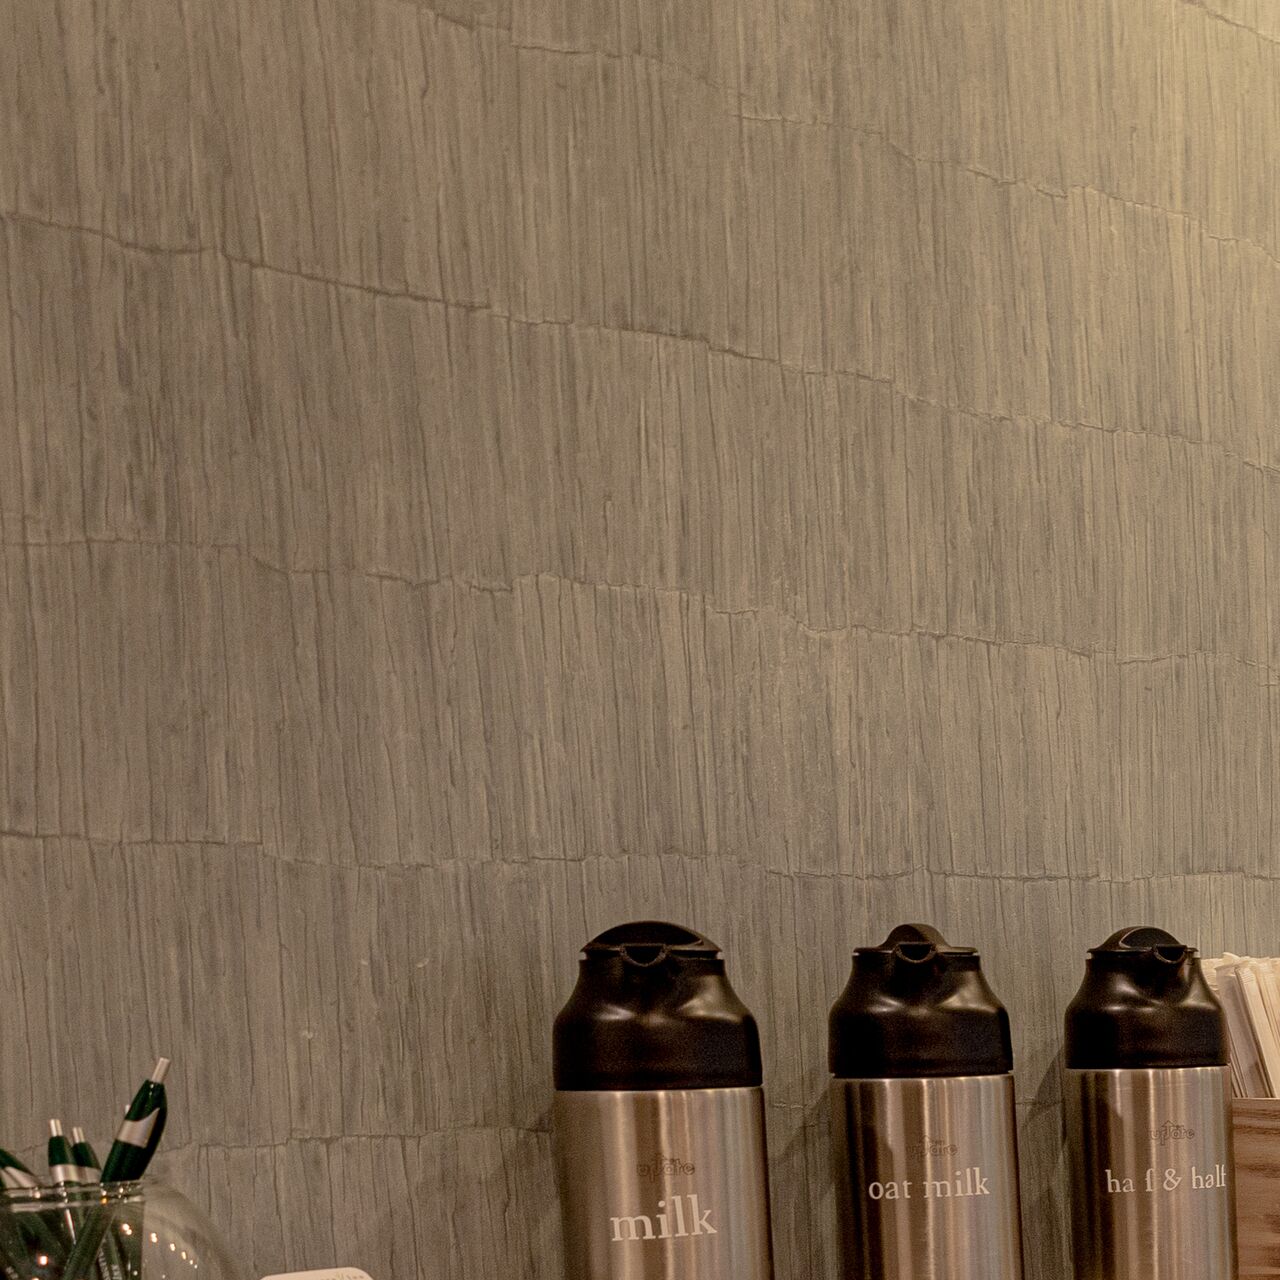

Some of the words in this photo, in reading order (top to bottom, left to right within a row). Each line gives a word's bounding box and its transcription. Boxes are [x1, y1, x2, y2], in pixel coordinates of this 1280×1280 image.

[868, 1180, 913, 1200] oat
[922, 1167, 990, 1199] milk
[1105, 1167, 1154, 1193] haf
[1162, 1168, 1182, 1191] &
[609, 1194, 718, 1242] milk
